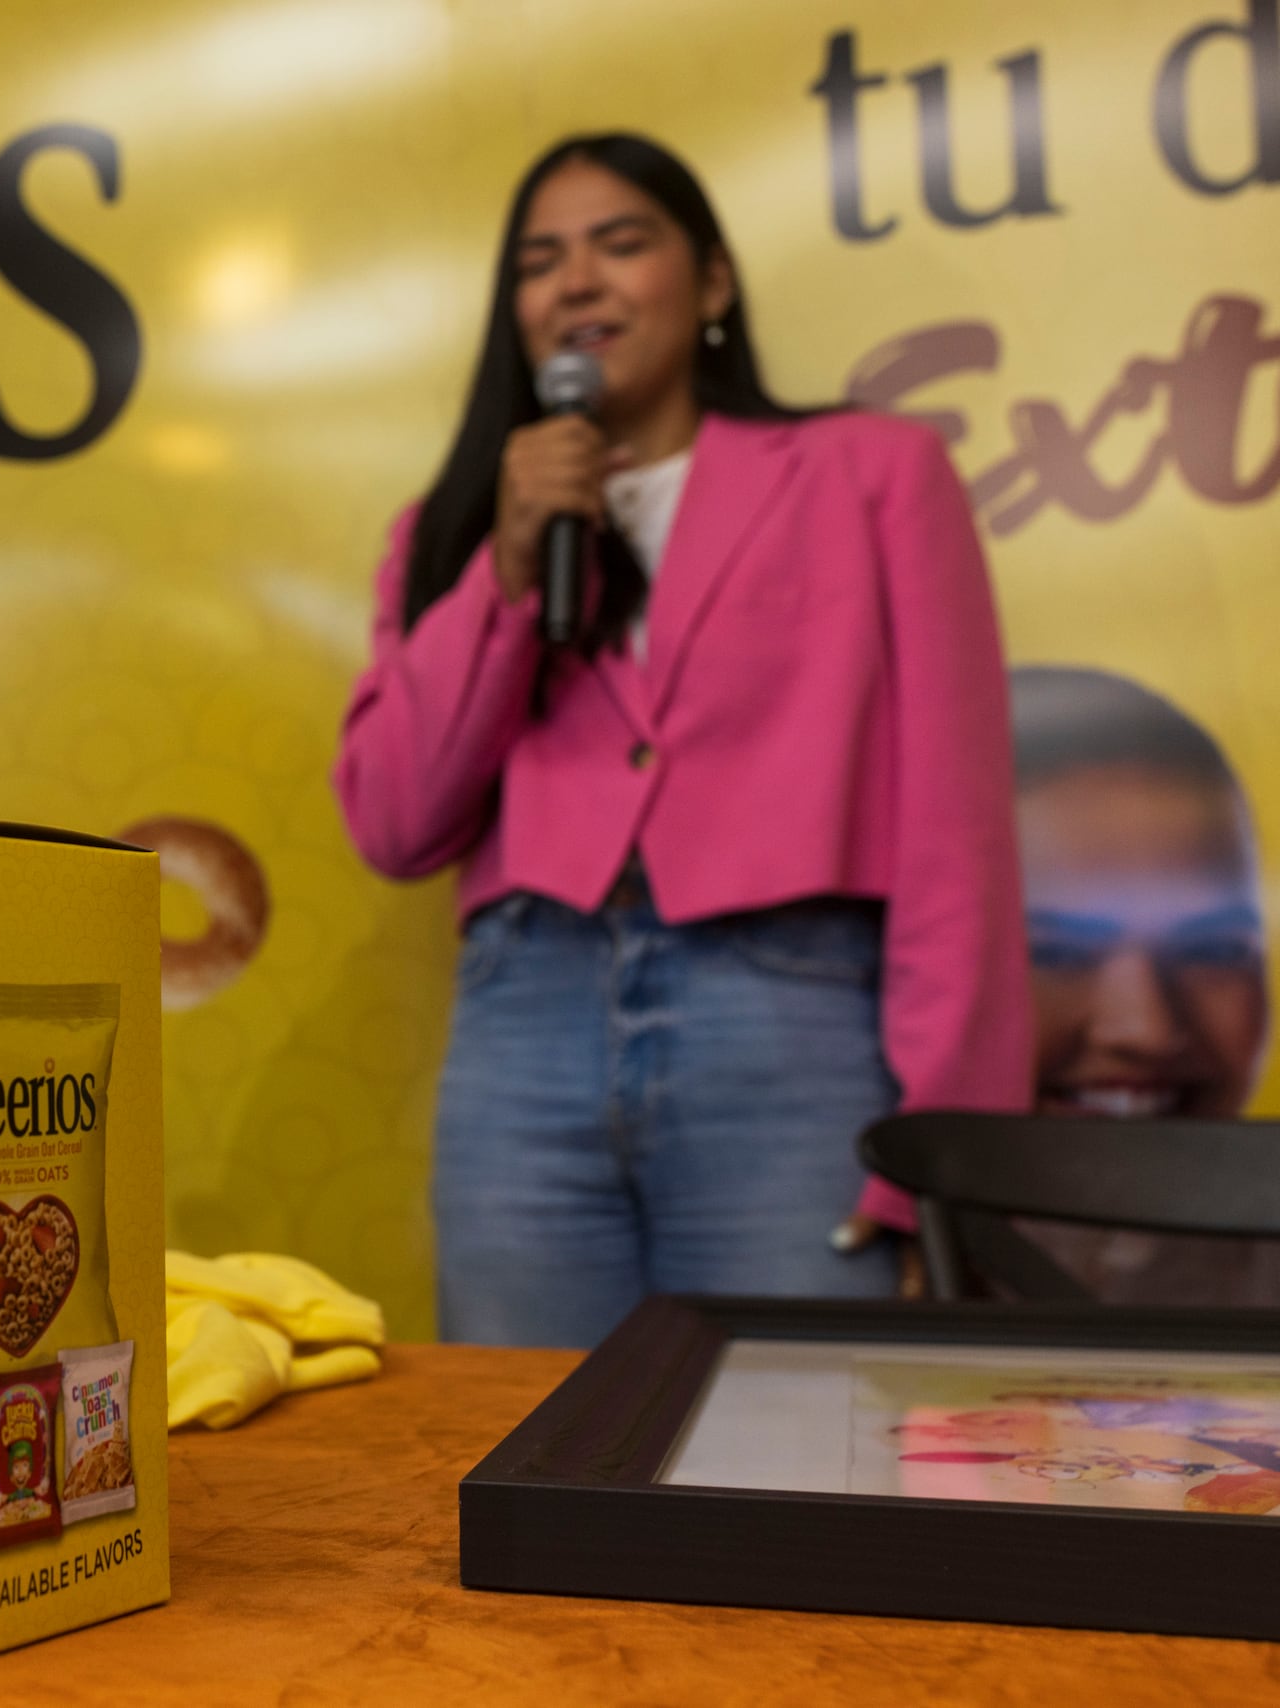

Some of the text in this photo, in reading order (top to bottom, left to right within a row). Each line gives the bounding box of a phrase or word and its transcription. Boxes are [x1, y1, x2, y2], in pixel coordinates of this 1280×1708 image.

[808, 28, 1065, 245] tu
[16, 1143, 39, 1158] Grain
[41, 1141, 56, 1157] Oat
[57, 1139, 82, 1155] Cereal
[37, 1165, 69, 1182] OATS
[75, 1529, 143, 1586] FLAVORS
